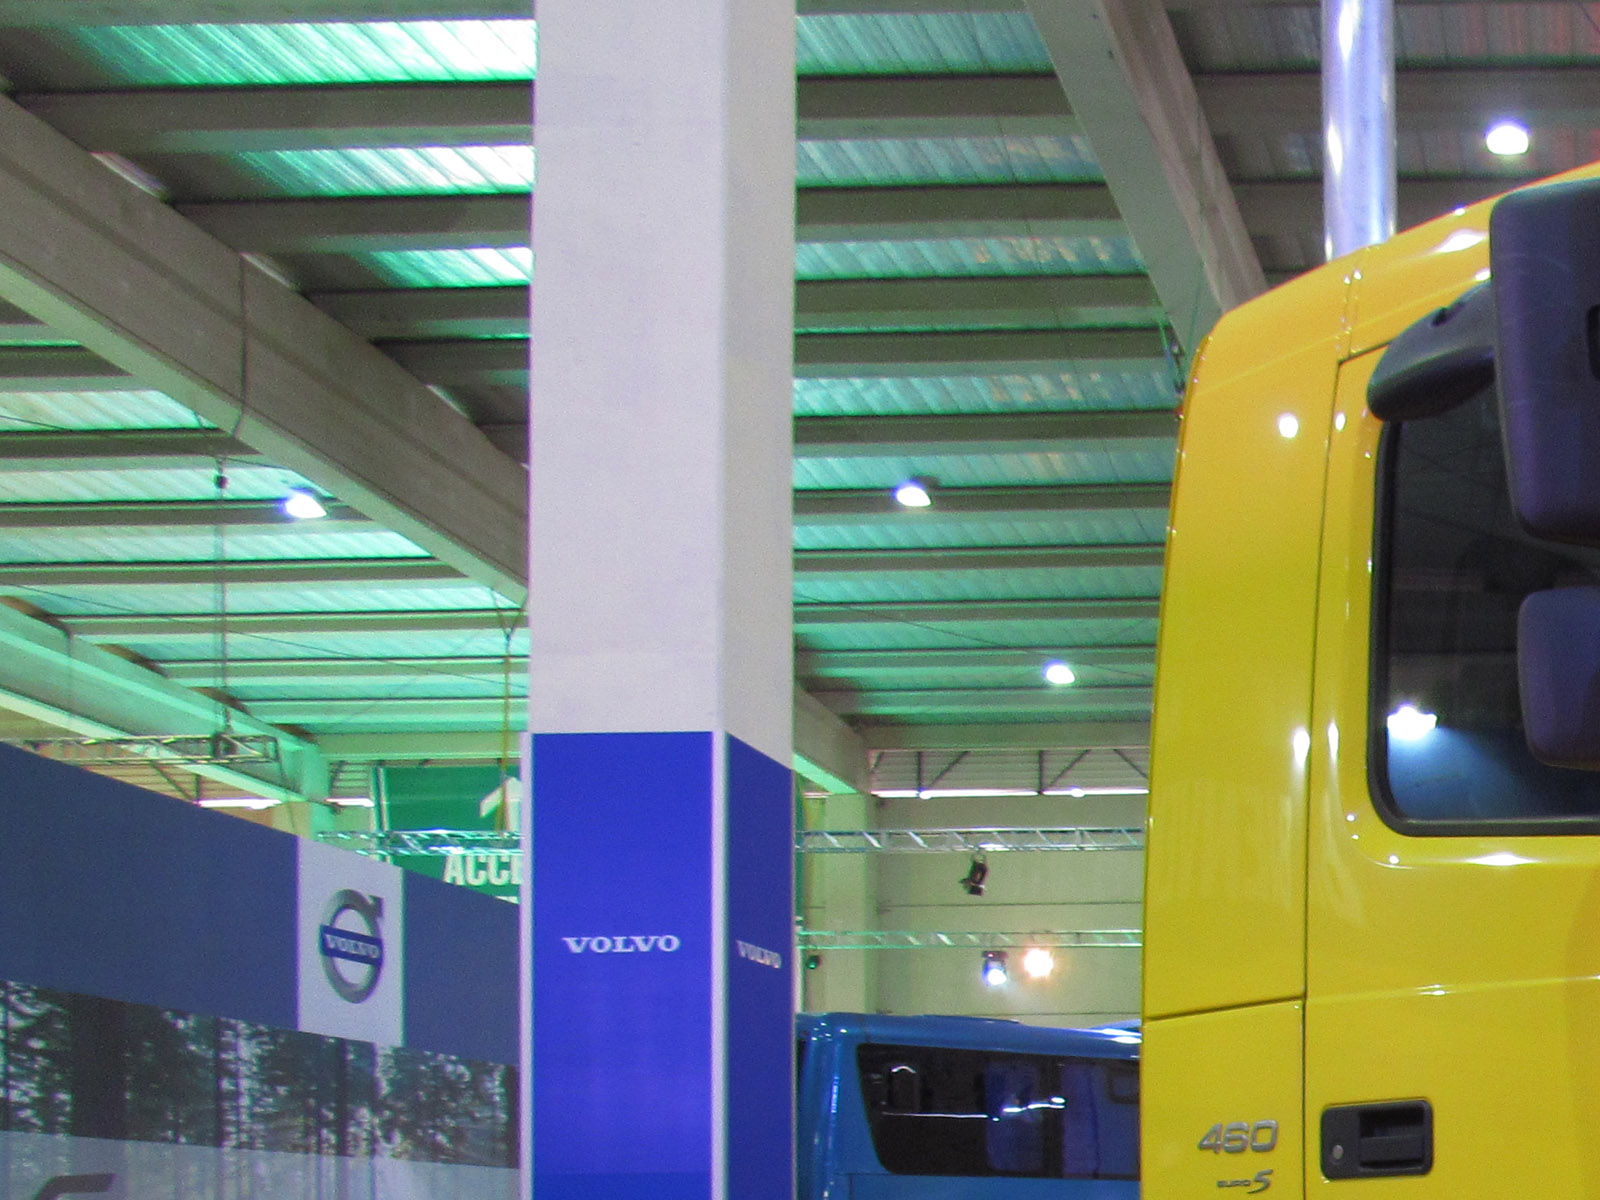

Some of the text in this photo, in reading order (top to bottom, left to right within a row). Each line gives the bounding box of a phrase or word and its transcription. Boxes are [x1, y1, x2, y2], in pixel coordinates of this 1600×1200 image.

[561, 934, 682, 954] VOLVO
[735, 939, 783, 969] VOLVO
[1197, 1119, 1278, 1154] 460
